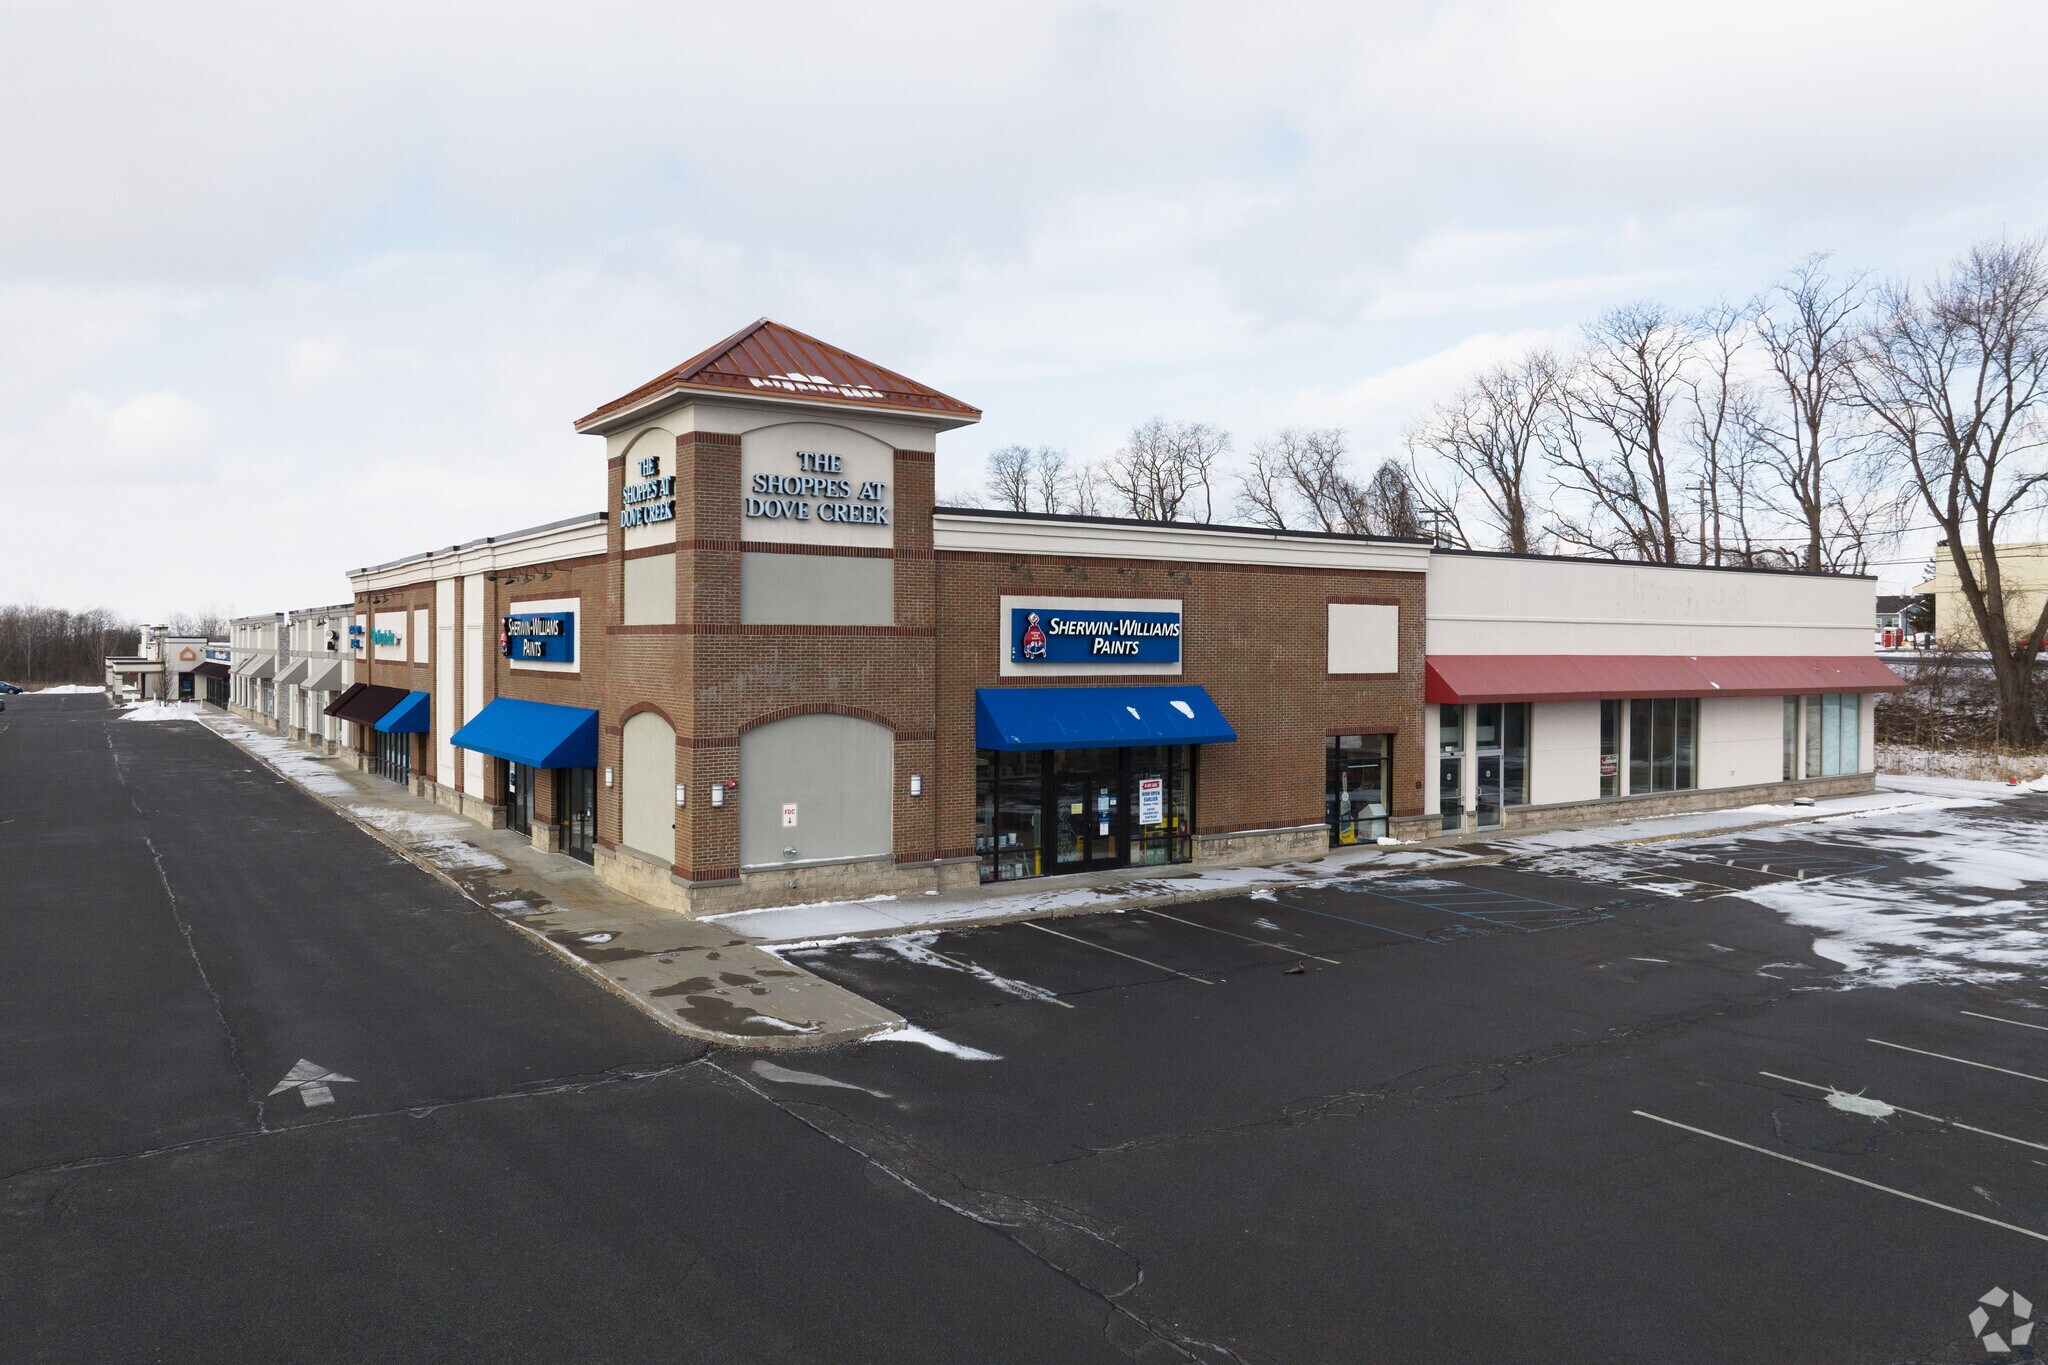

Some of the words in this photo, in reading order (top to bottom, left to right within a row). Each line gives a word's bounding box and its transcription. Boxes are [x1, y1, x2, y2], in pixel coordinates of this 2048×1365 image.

[638, 456, 657, 477] THE
[797, 451, 843, 473] THE
[623, 480, 658, 504] SHOPPES
[660, 476, 673, 496] AT
[753, 473, 851, 498] SHOPPES
[858, 481, 886, 500] AT
[621, 508, 642, 527] DOVE
[644, 500, 673, 523] CREEK
[746, 498, 811, 520] DOVE
[817, 502, 889, 525] CREEK
[508, 617, 559, 636] SHERWIN-WILLIAMS
[1049, 618, 1180, 636] SHERWIN-WILLIAMS
[523, 639, 542, 656] PAINTS
[1093, 638, 1139, 655] PAINTS
